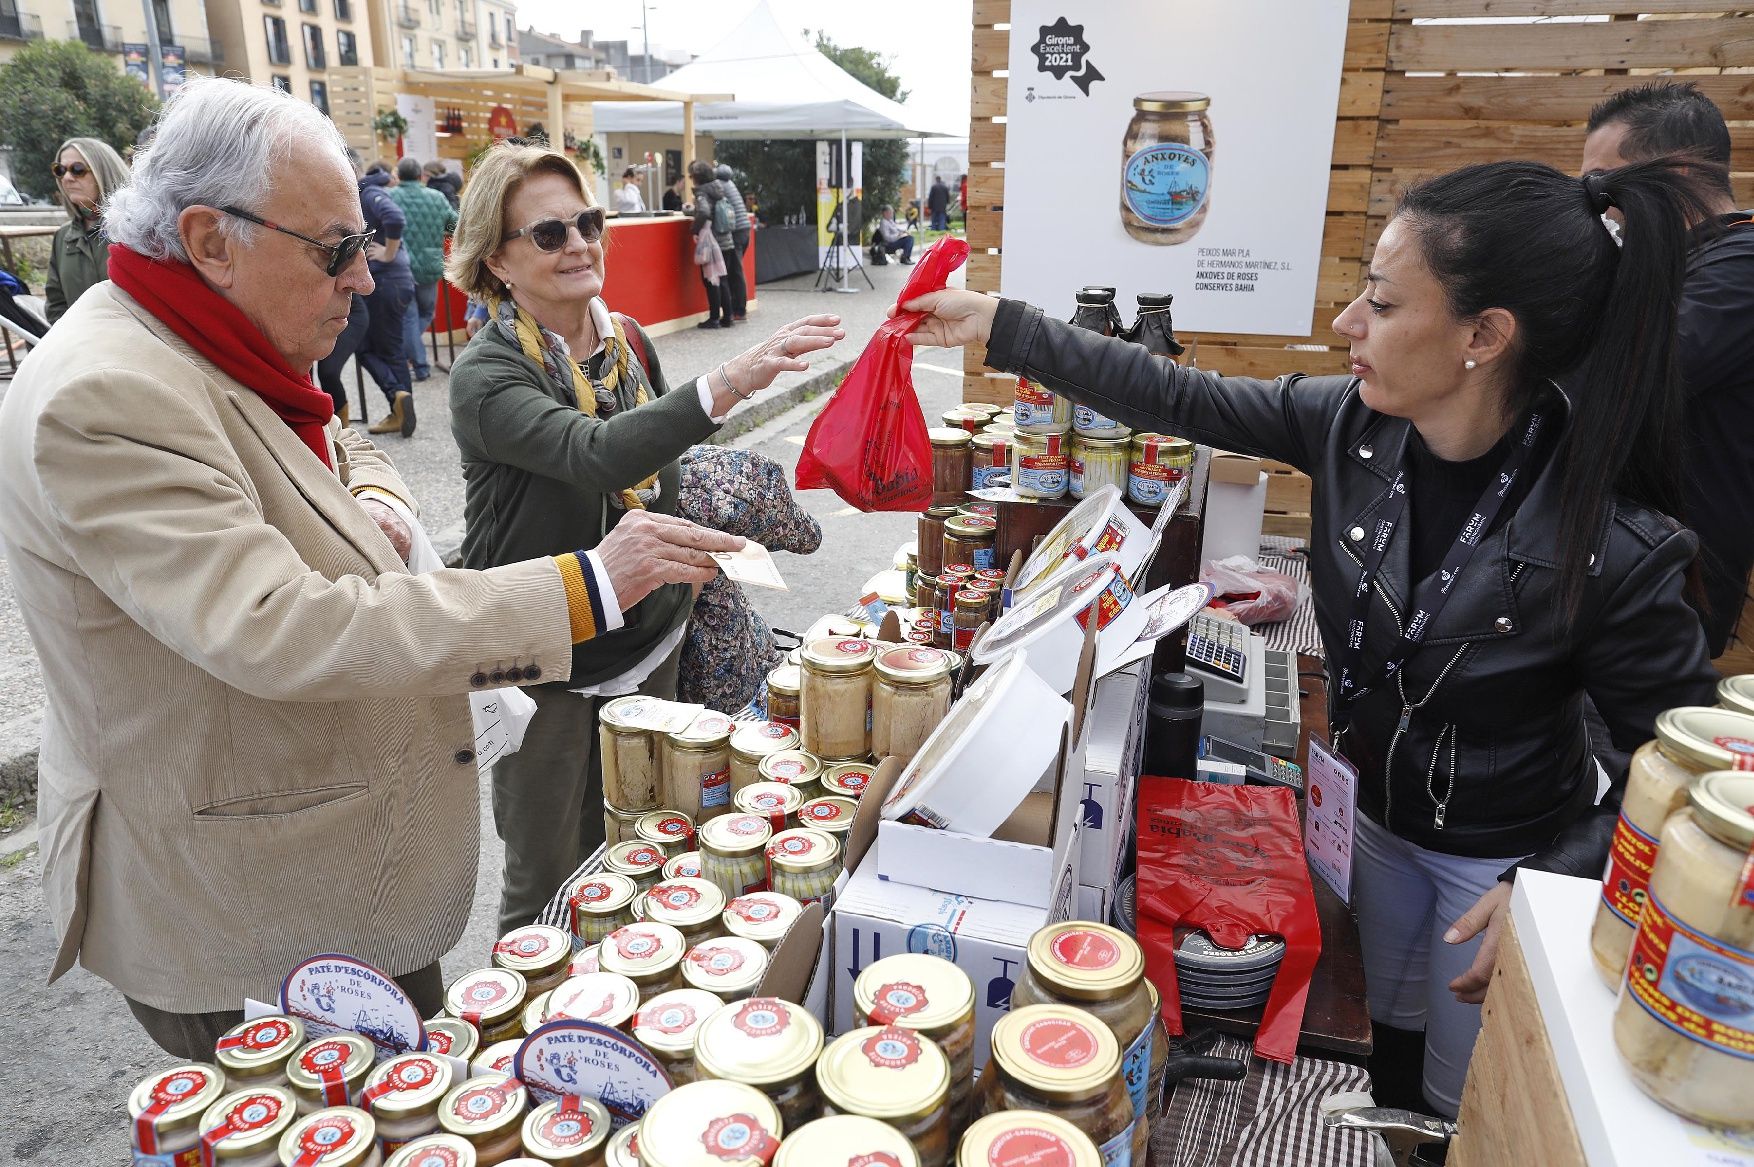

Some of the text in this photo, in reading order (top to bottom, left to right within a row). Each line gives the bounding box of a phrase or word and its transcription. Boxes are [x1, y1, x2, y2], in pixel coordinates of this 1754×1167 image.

[1045, 34, 1074, 45] Girona
[1045, 53, 1073, 66] 2021
[1197, 247, 1250, 258] PEIXOS MAR PLA
[1197, 259, 1206, 269] DE
[1207, 260, 1244, 269] HERMANOS
[1196, 271, 1259, 281] ANXOVES DE ROSES
[1195, 282, 1234, 292] CONSERVES
[308, 963, 405, 1006] PATÉ D'ESCÓRPORA
[350, 978, 362, 988] DE
[340, 984, 373, 1000] ROSES
[546, 1032, 658, 1079] PATÉ D'ESCÓRPORA
[594, 1049, 610, 1061] DE
[583, 1055, 621, 1073] ROSES
